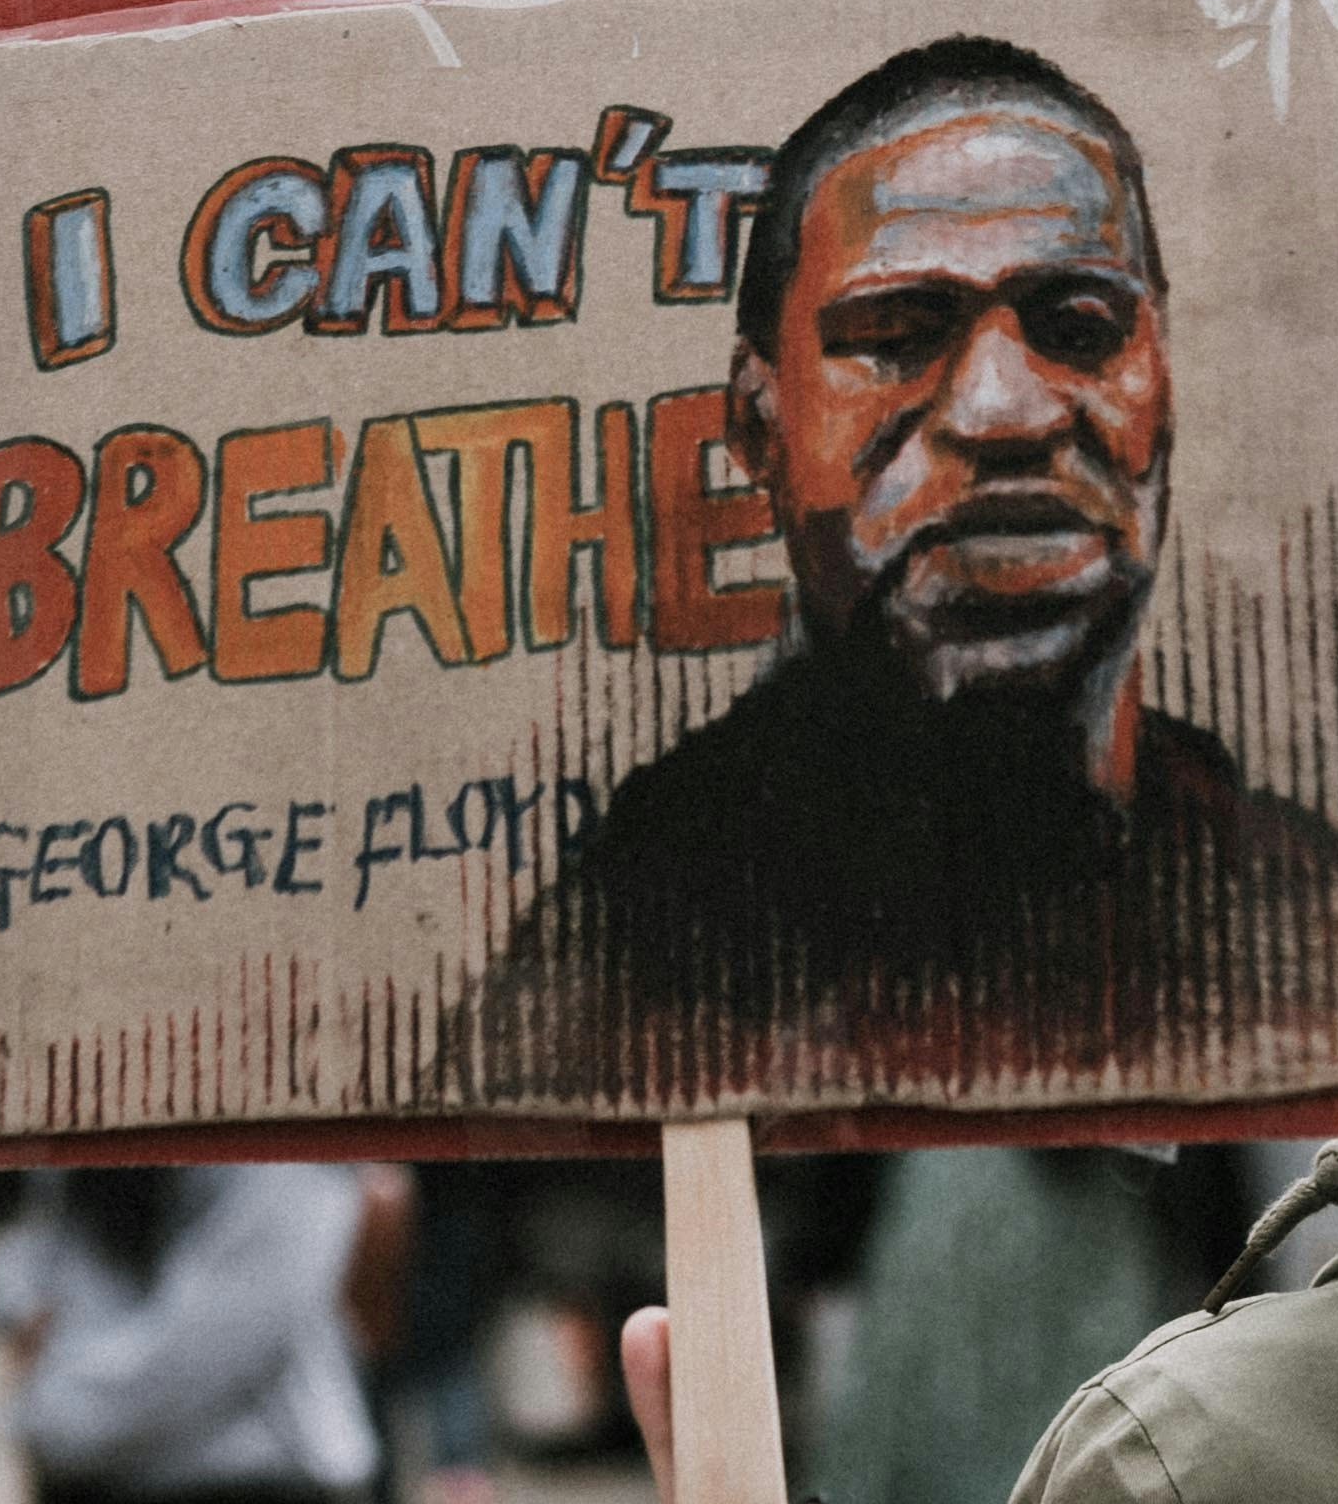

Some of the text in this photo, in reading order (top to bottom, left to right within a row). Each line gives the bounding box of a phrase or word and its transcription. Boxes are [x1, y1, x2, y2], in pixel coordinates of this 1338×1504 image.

[23, 104, 773, 373] I CAN'T
[353, 772, 599, 912] FLOYD
